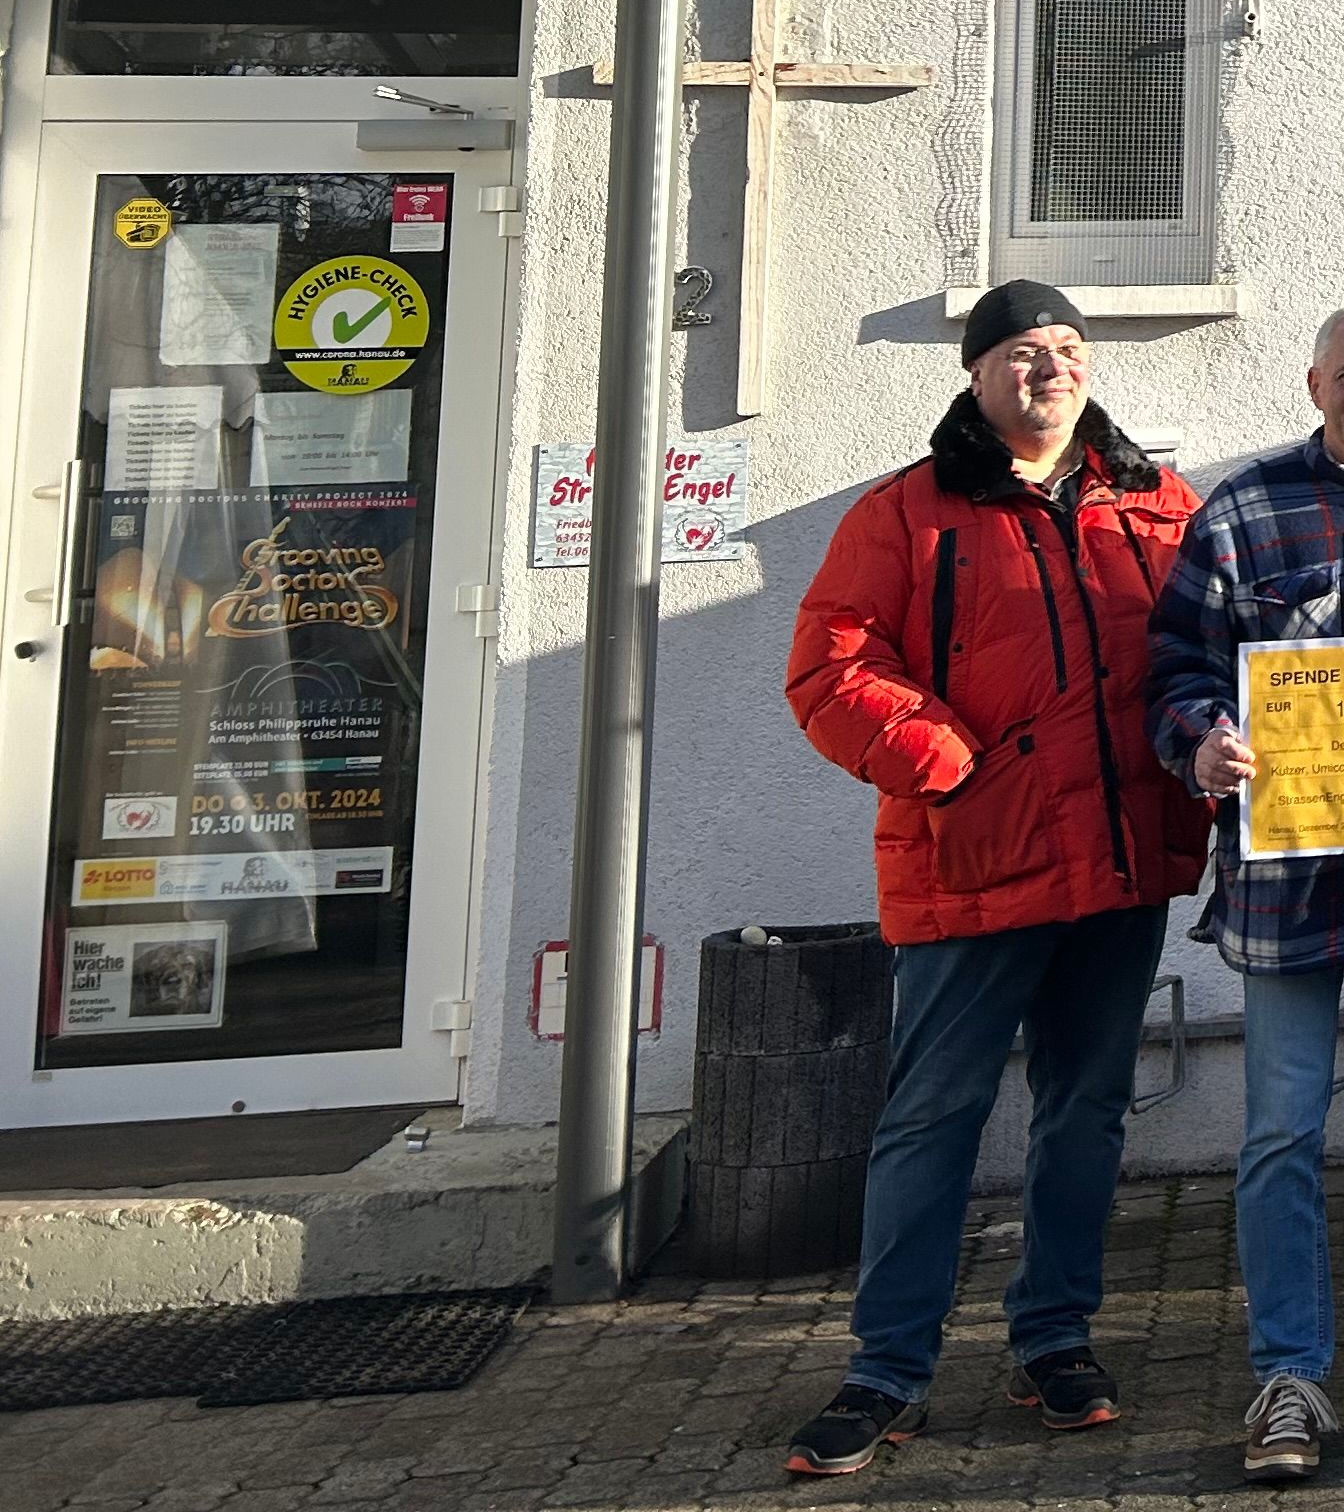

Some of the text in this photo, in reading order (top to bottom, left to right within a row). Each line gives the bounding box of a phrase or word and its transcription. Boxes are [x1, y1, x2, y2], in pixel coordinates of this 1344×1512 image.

[288, 266, 418, 320] HYGIENE-CHECK
[673, 265, 713, 332] 2
[295, 349, 406, 359] www.corona.hanau.de
[240, 538, 385, 571] Grooving
[1270, 668, 1341, 686] SPENDE
[211, 698, 383, 717] AMPHITHEATER
[1266, 701, 1291, 712] EUR
[209, 716, 381, 732] Schloss Philippsruhe Hanau
[208, 735, 226, 744] Am
[228, 732, 300, 745] Amphitheater
[346, 729, 379, 738] Hanau
[191, 795, 224, 814] DO
[275, 791, 325, 810] OKT.
[330, 788, 381, 808] 2024
[189, 813, 295, 835] 19.30 UHR
[104, 869, 155, 883] LOTTO
[74, 940, 106, 955] Hier
[73, 955, 125, 971] wache
